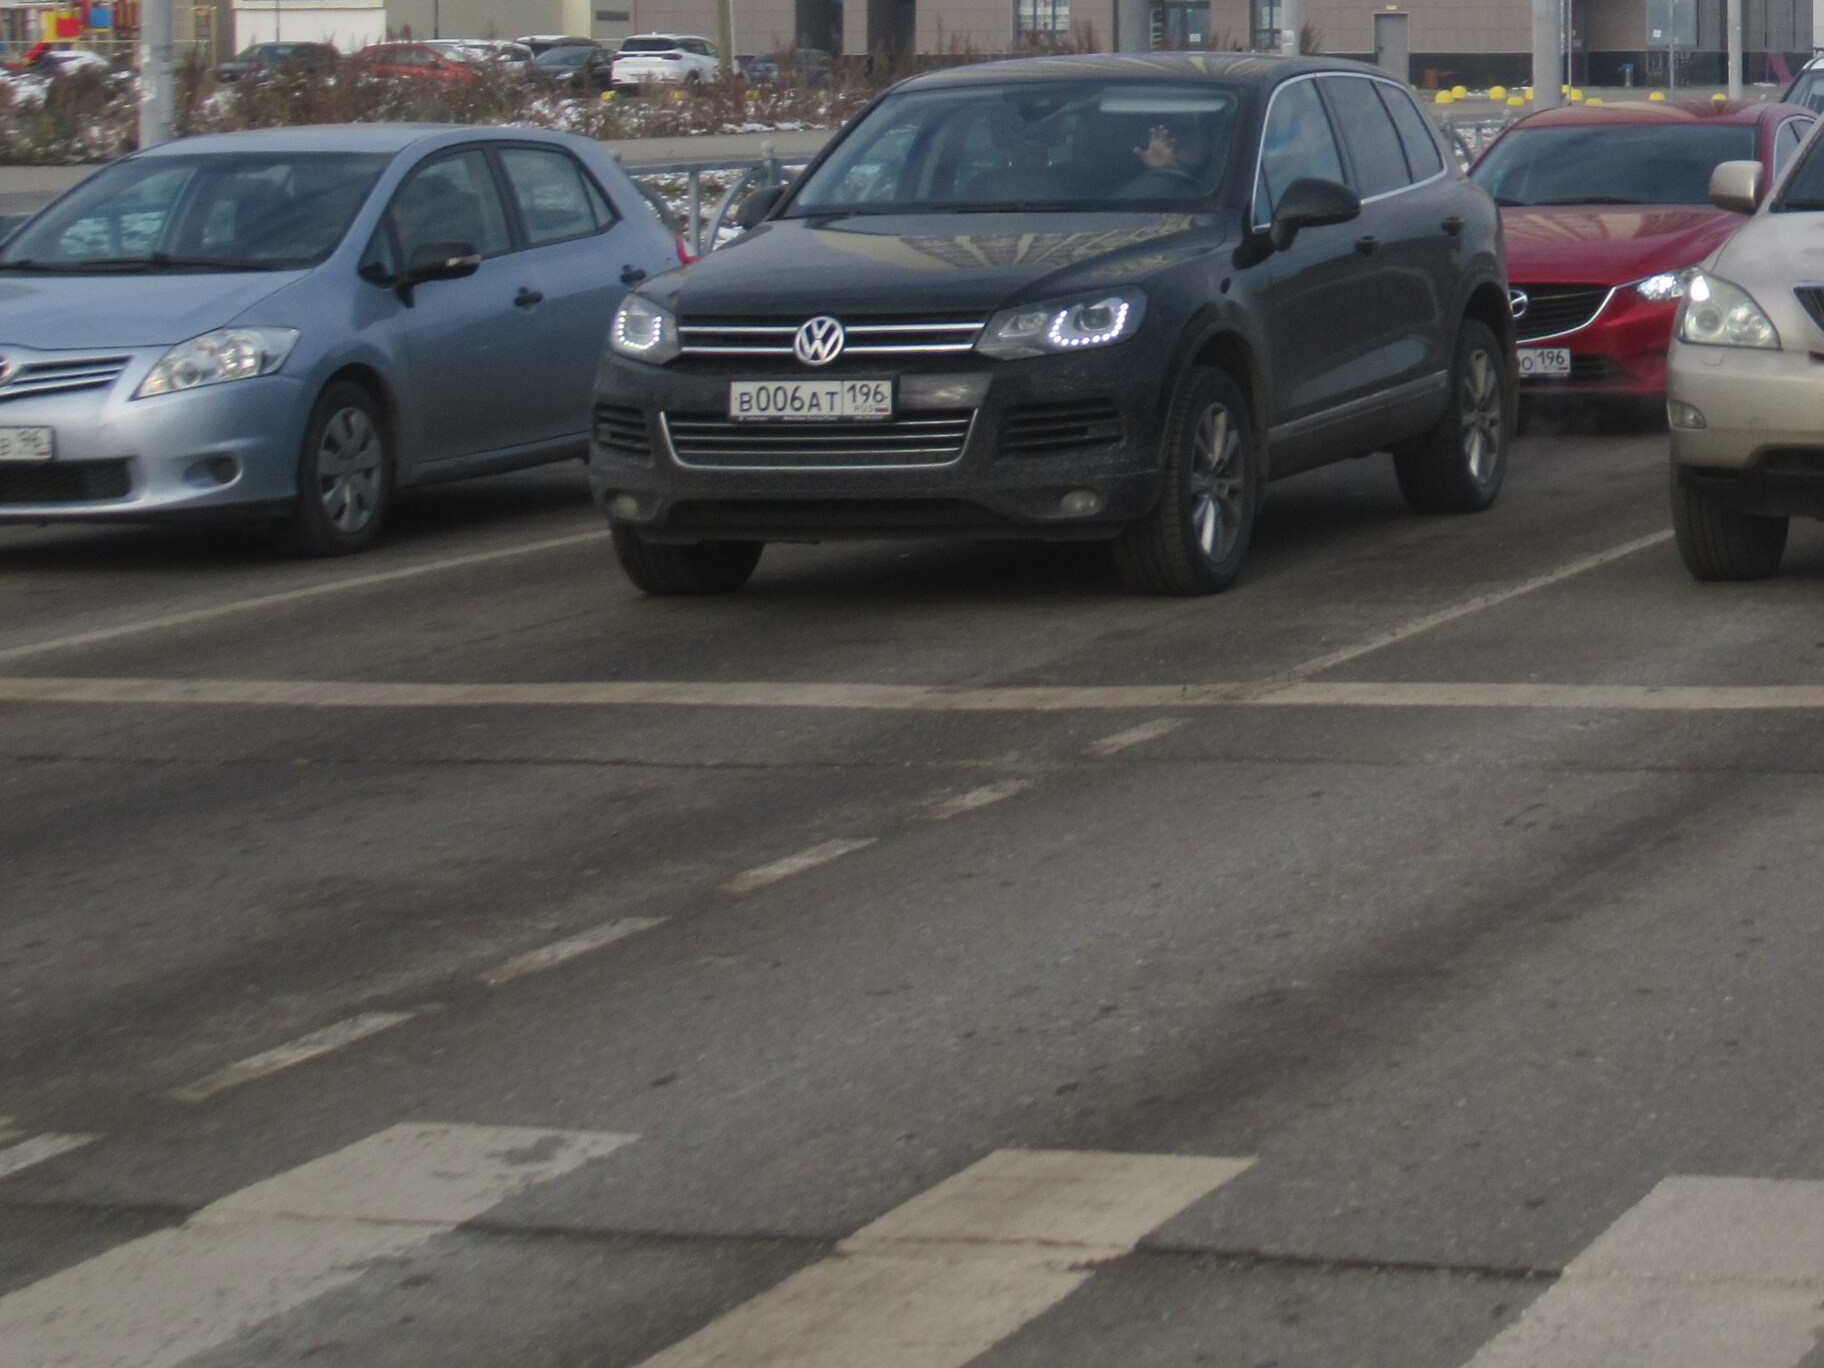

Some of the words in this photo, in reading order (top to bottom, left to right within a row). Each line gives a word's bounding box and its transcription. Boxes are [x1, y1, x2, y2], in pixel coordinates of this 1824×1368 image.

[1537, 350, 1565, 366] 196
[739, 385, 839, 413] В006АТ
[846, 383, 886, 404] 196
